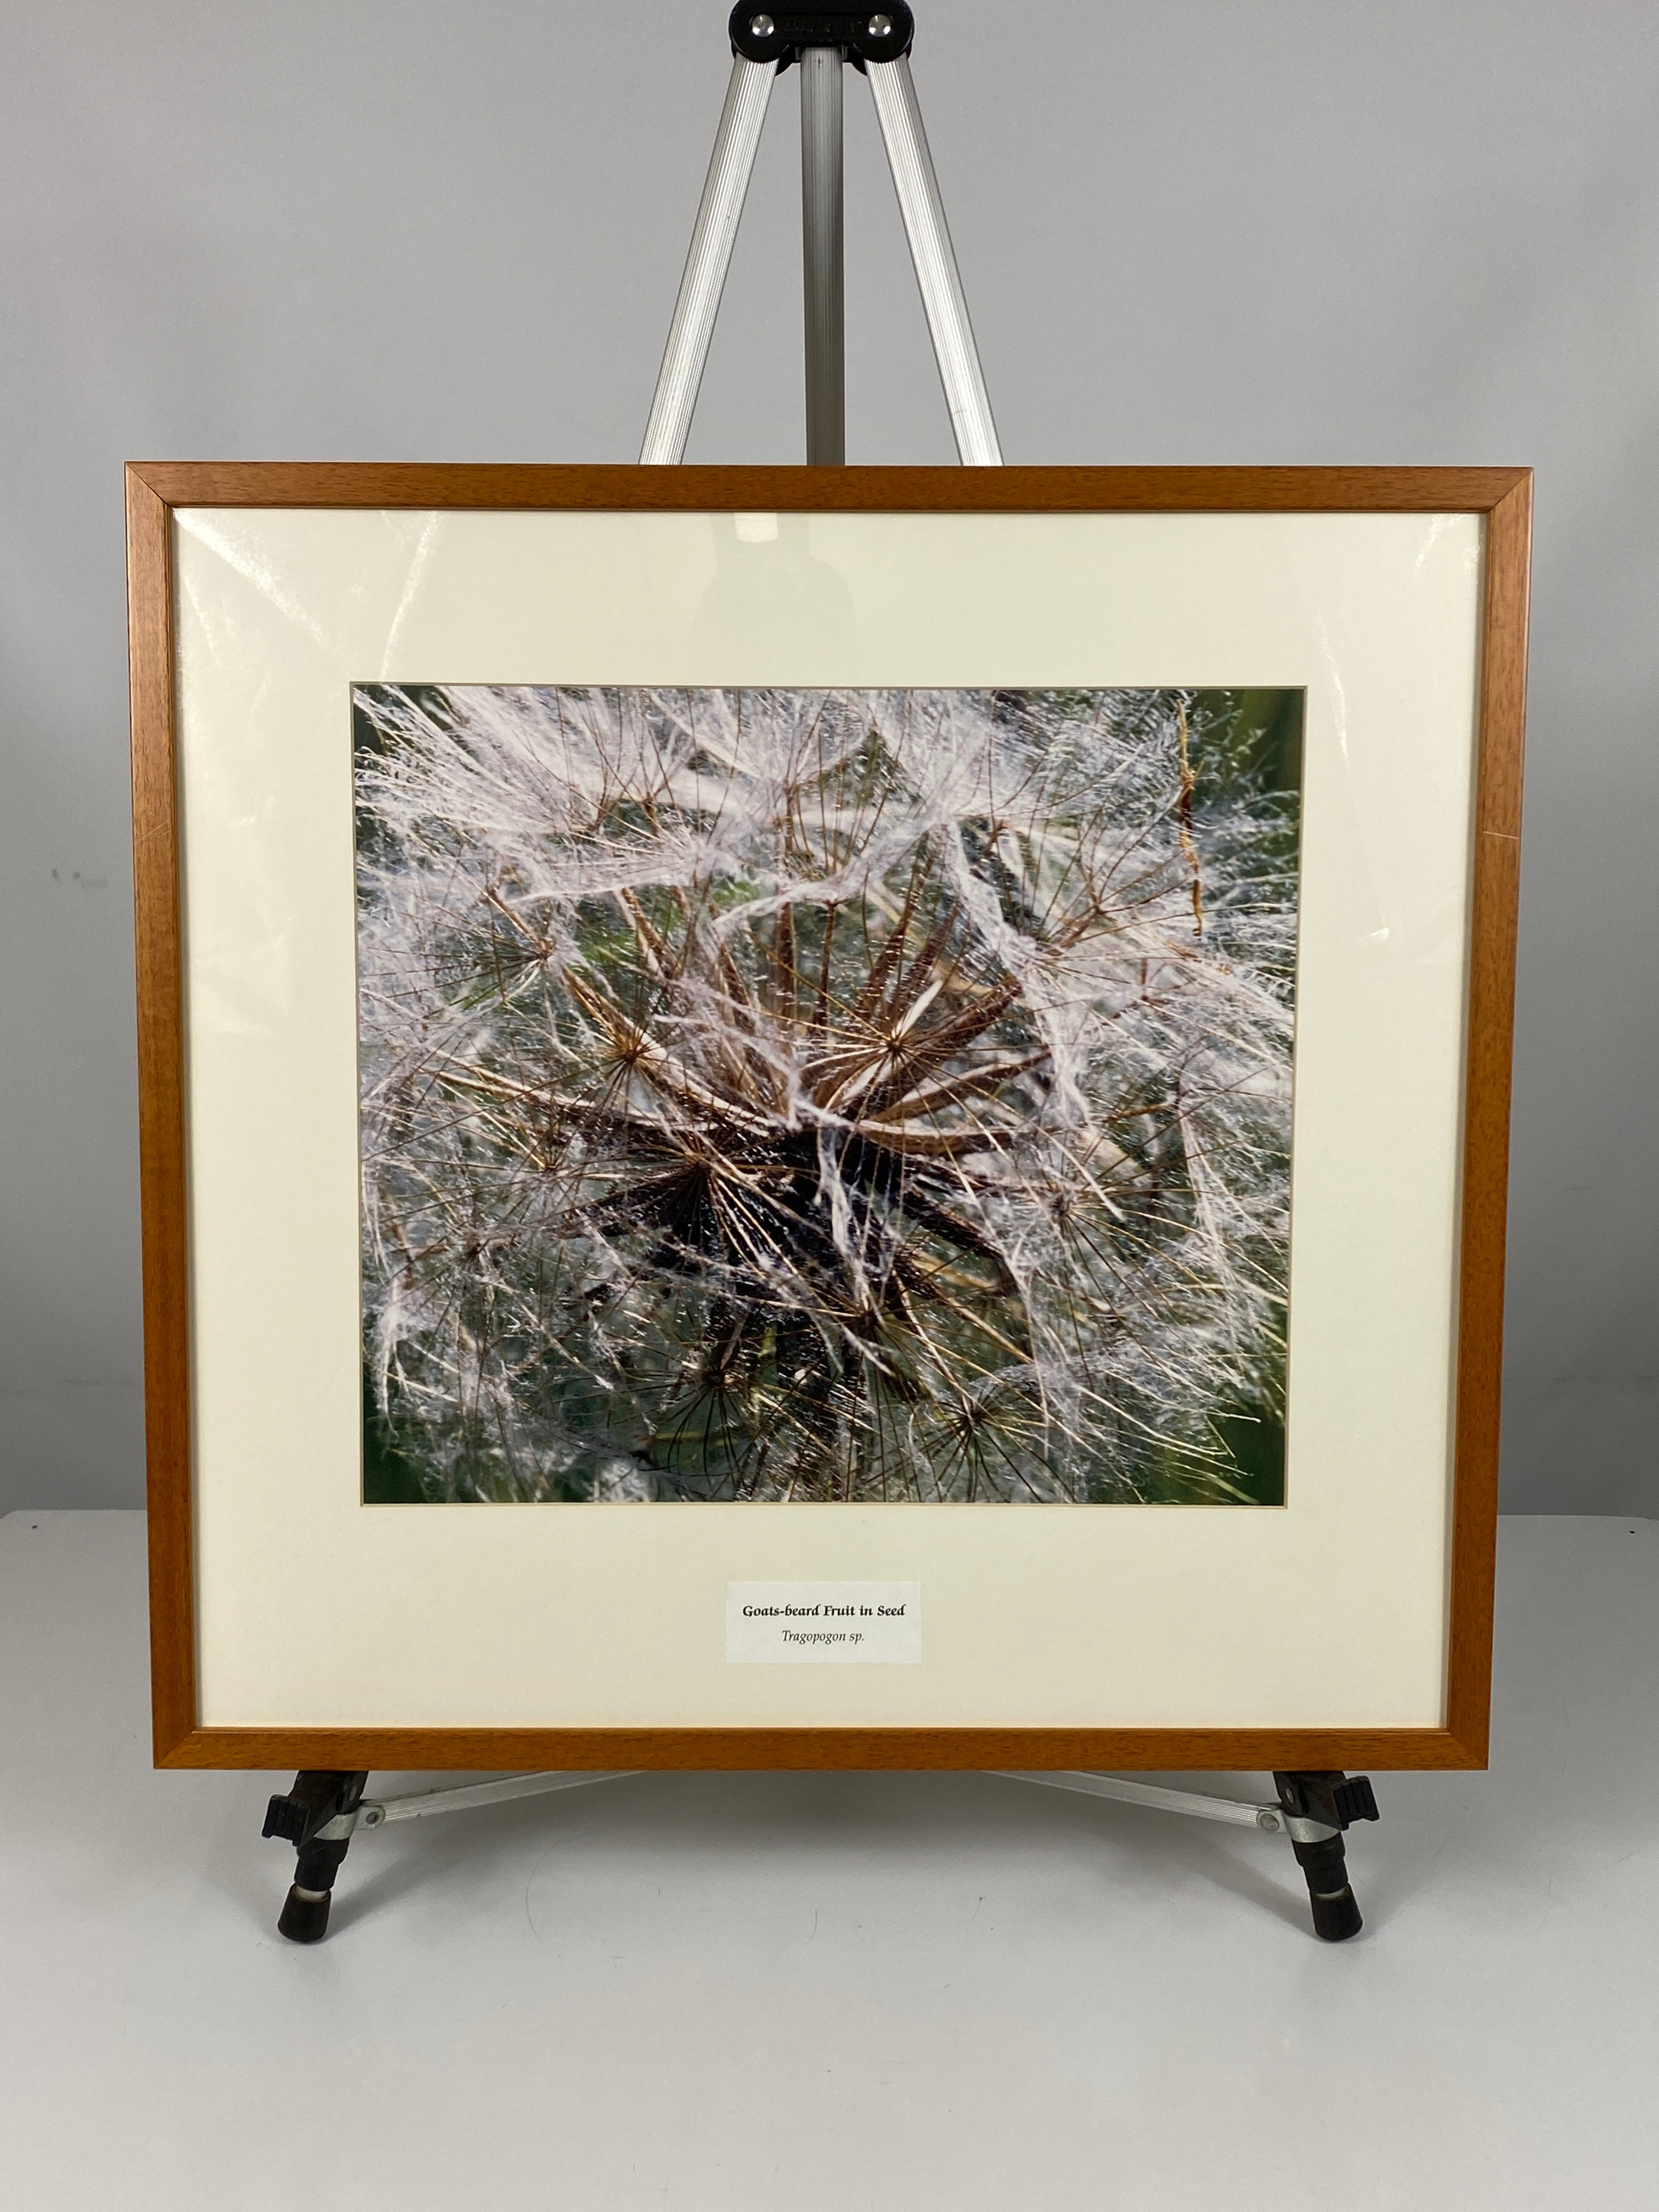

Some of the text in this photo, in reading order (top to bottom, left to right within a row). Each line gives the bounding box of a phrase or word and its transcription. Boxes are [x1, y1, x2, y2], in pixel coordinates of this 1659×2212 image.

[743, 1604, 906, 1617] Goats-beard Fruit in Seed
[782, 1630, 865, 1645] Tragopogon sp.
